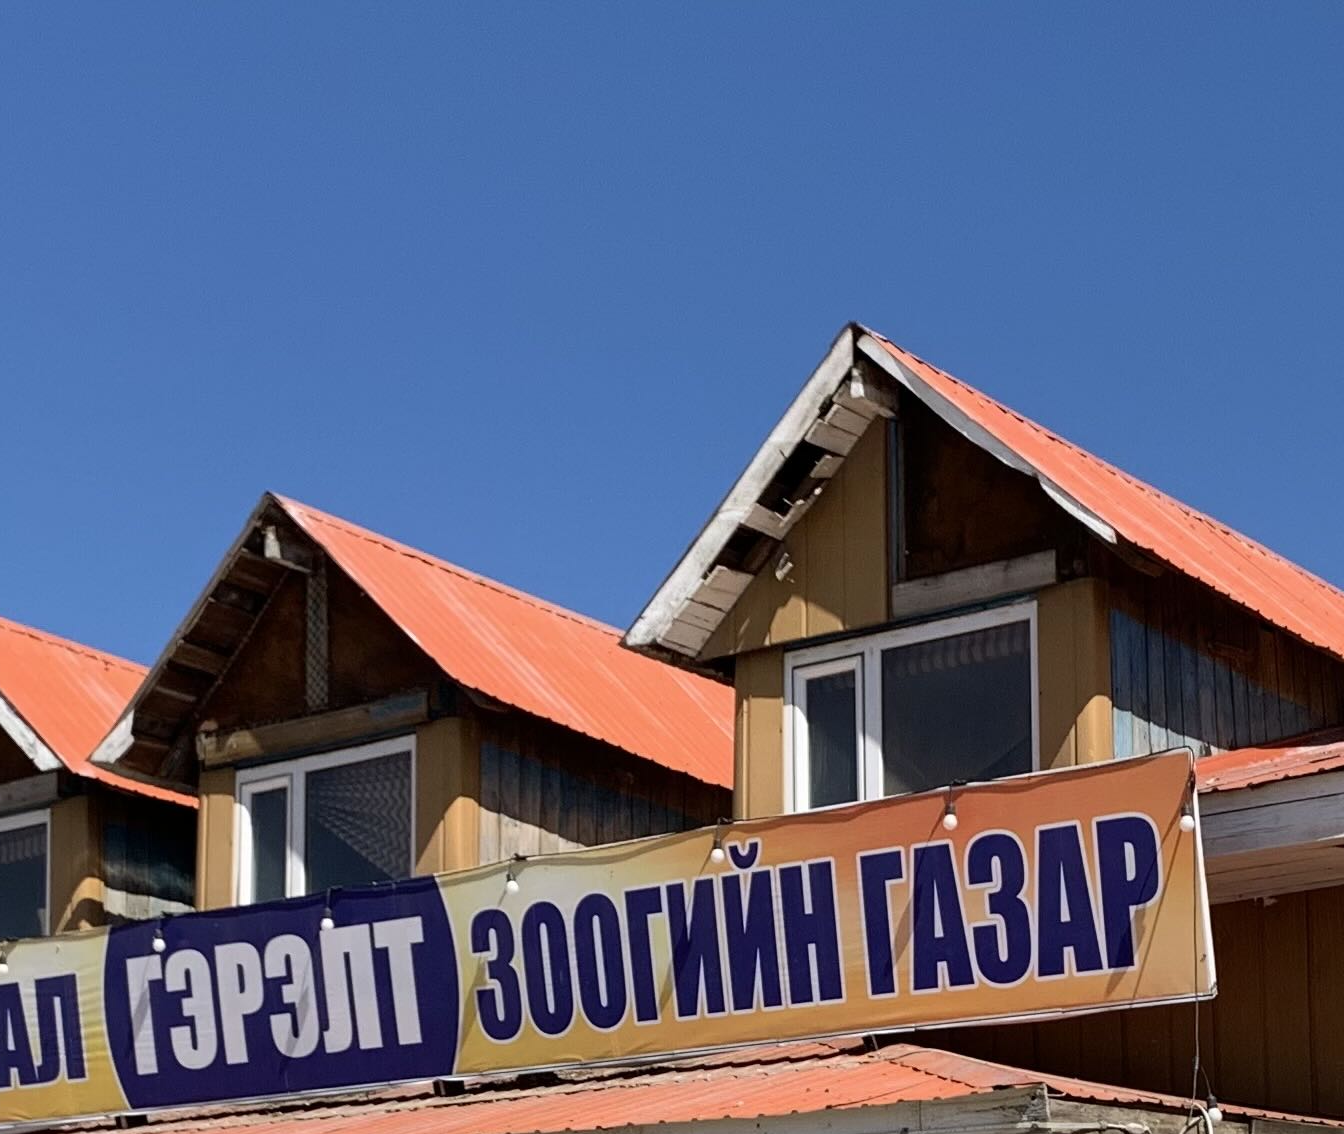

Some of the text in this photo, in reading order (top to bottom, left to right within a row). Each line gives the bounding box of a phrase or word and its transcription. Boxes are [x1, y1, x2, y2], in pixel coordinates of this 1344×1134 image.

[124, 915, 424, 1076] ГЭРЭЛТ
[470, 840, 845, 1042] ЗООГИЙН
[859, 814, 1161, 997] ГАЗАР
